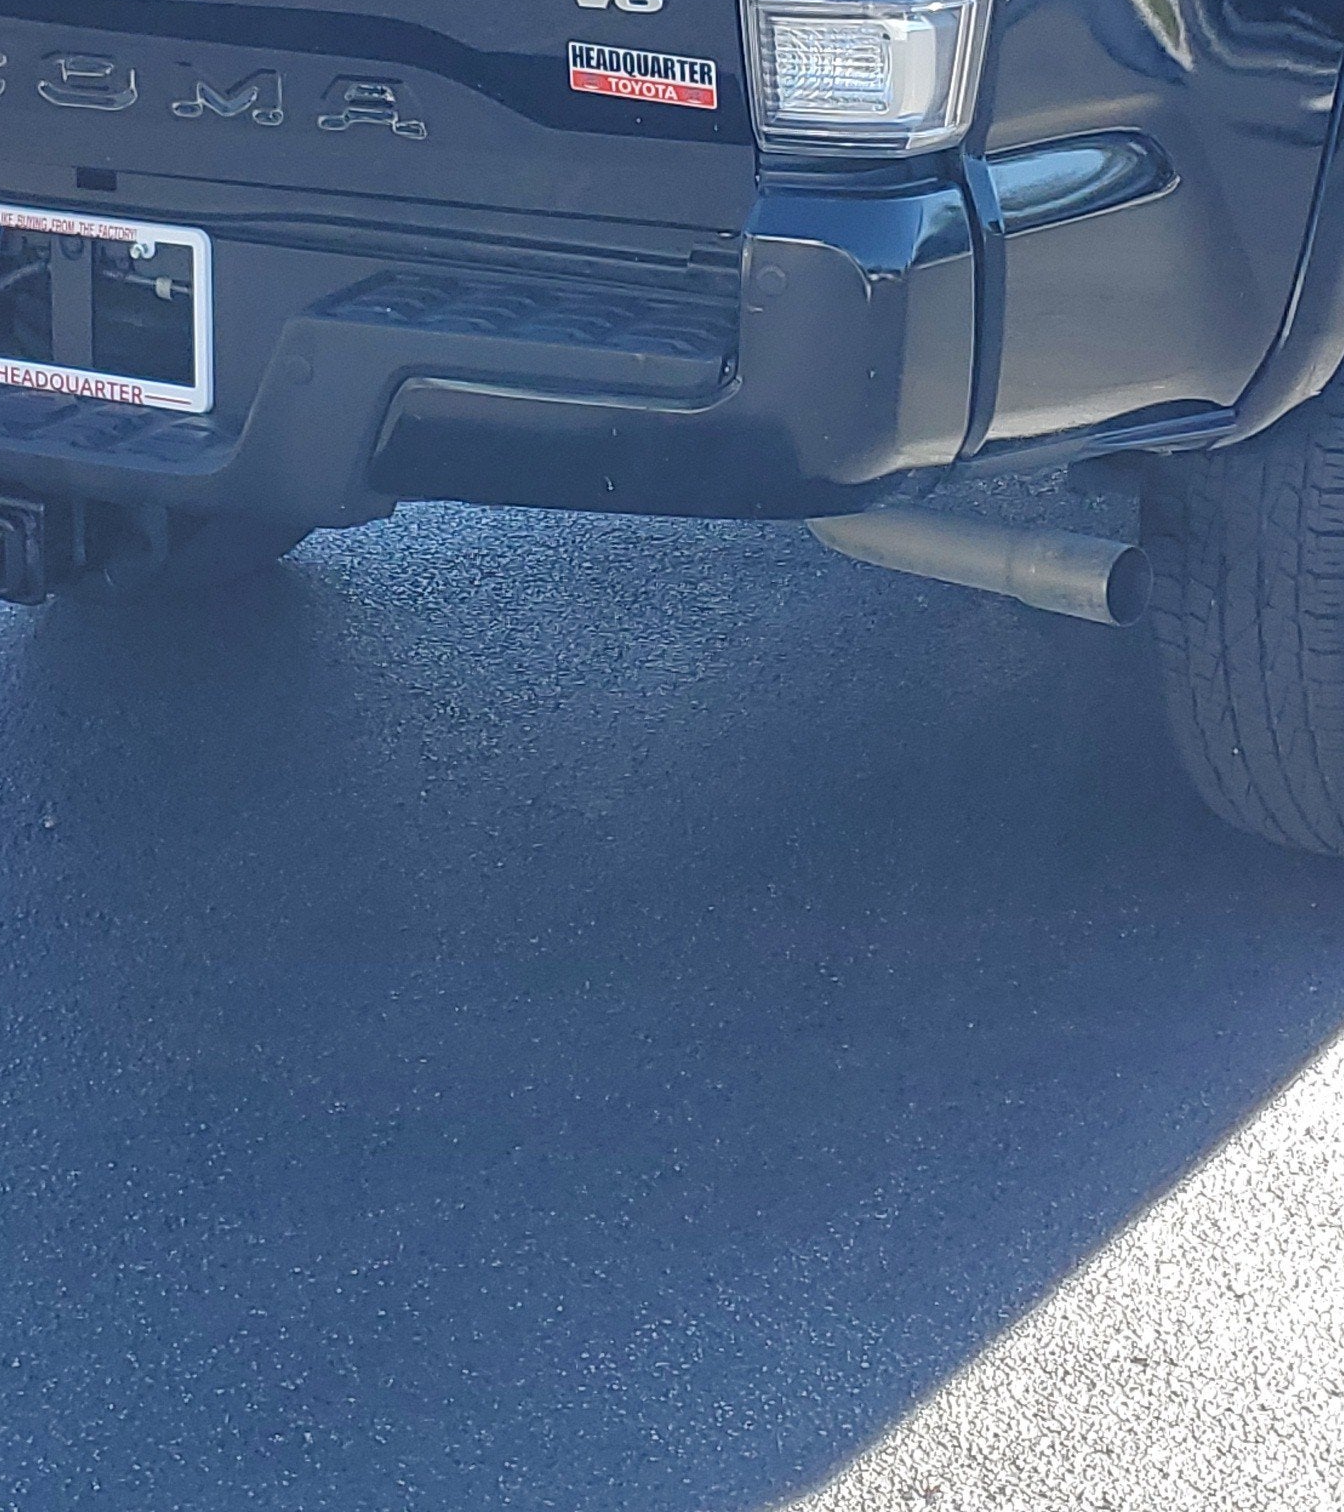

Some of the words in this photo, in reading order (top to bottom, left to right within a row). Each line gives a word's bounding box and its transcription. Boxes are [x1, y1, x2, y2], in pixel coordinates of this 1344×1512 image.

[571, 44, 713, 86] HEADQUARTER
[607, 77, 679, 101] TOYOTA
[79, 222, 96, 235] THE
